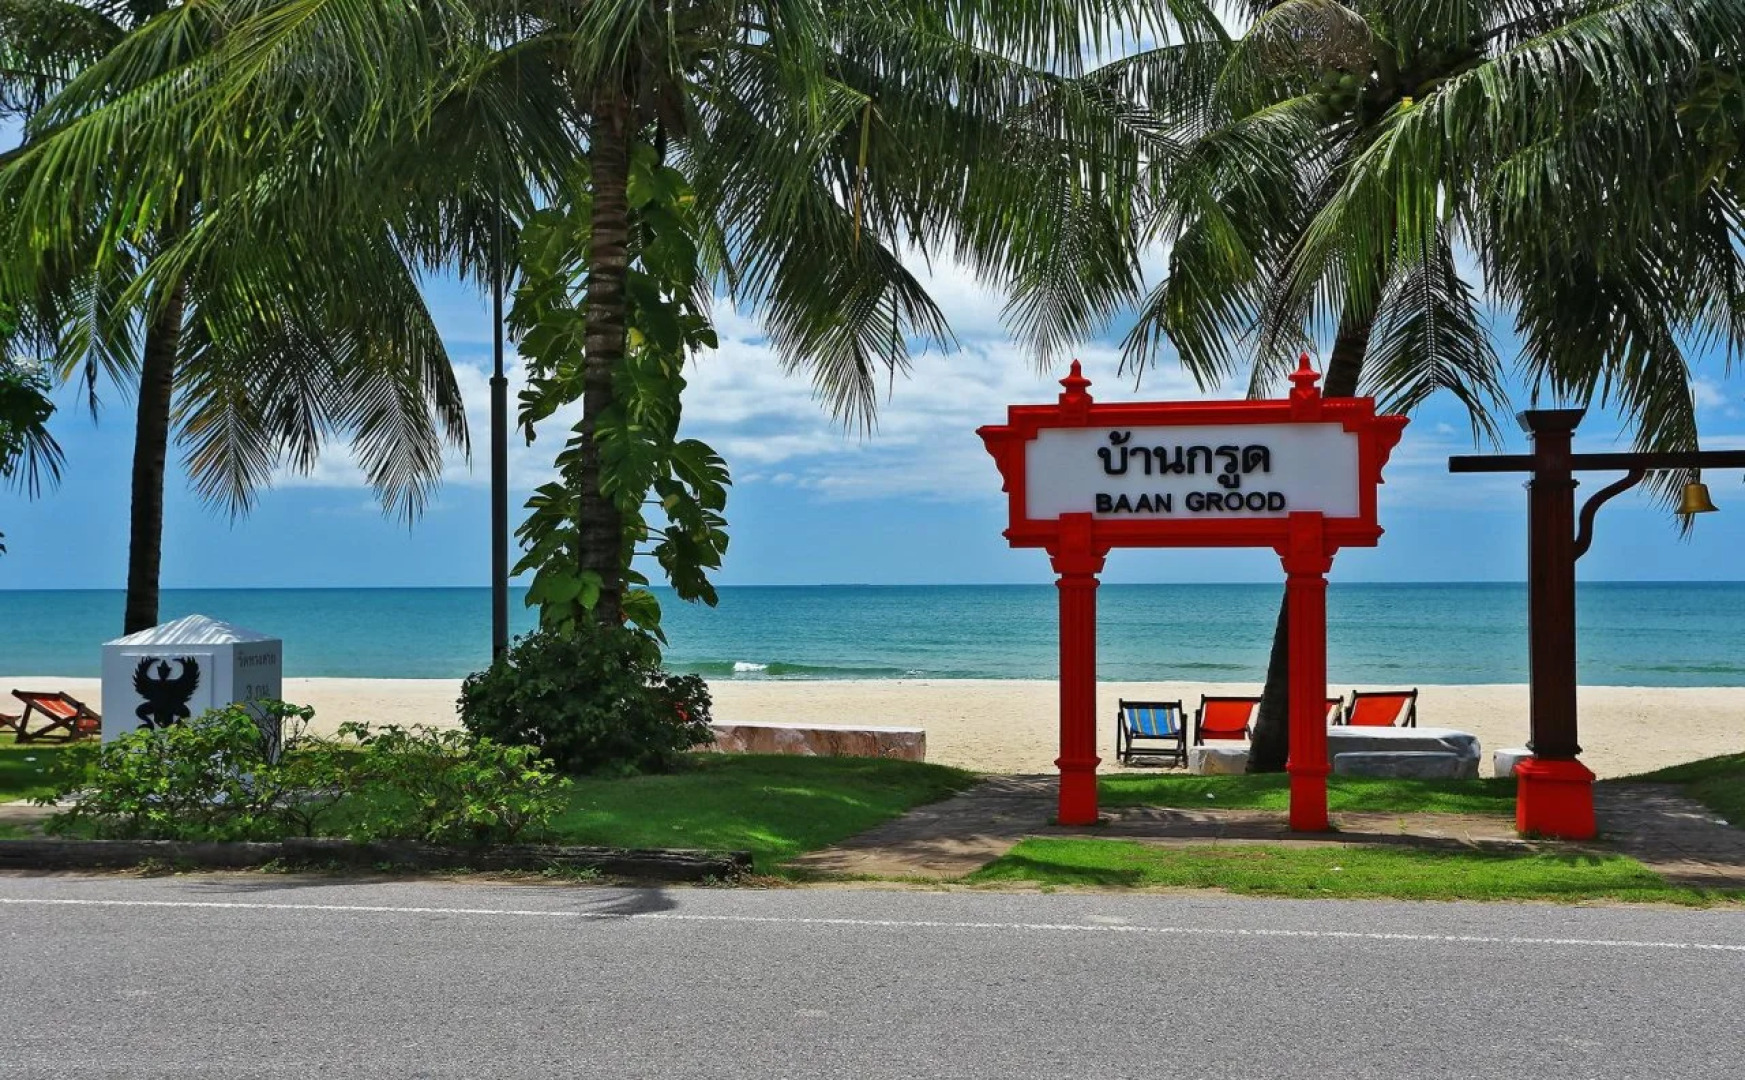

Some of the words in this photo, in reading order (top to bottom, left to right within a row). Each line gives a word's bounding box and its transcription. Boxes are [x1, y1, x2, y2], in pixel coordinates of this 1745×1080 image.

[1097, 430, 1271, 489] บ้านกรูด
[1095, 492, 1172, 513] BAAN
[1185, 491, 1286, 512] GROOD
